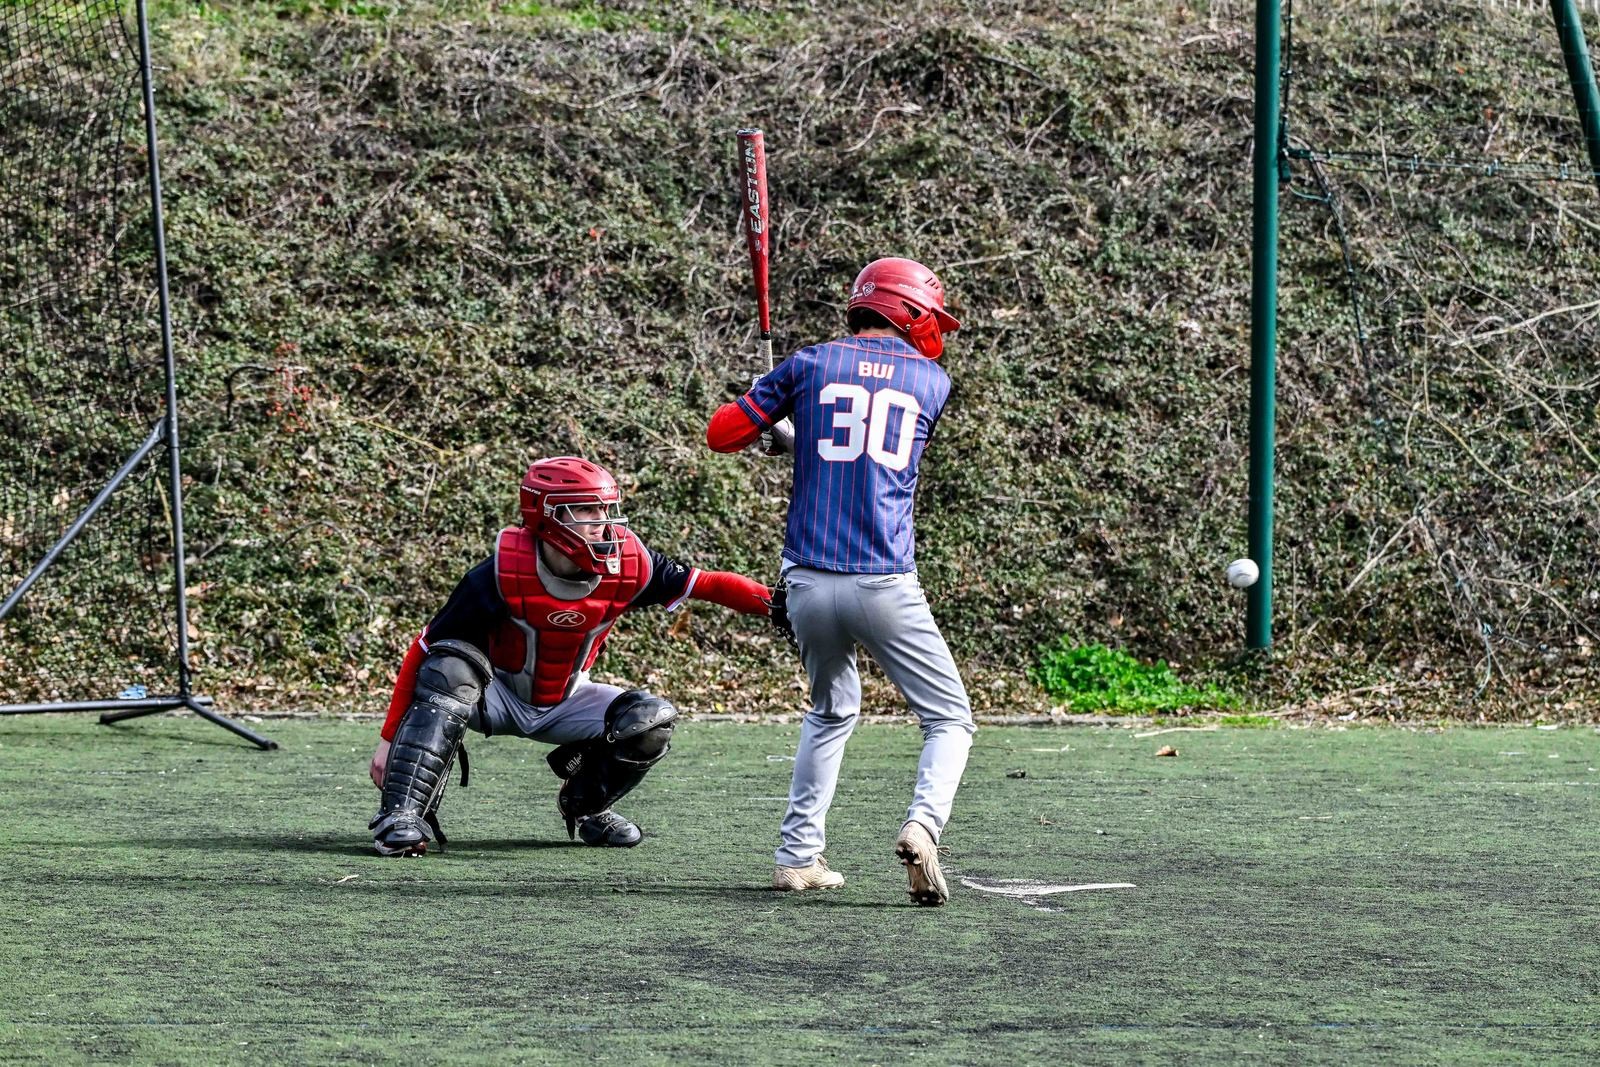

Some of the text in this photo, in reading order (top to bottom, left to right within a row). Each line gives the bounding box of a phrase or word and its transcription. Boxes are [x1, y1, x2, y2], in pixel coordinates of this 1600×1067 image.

[744, 140, 762, 234] EASTON
[858, 361, 895, 380] BUI
[817, 383, 922, 472] 30
